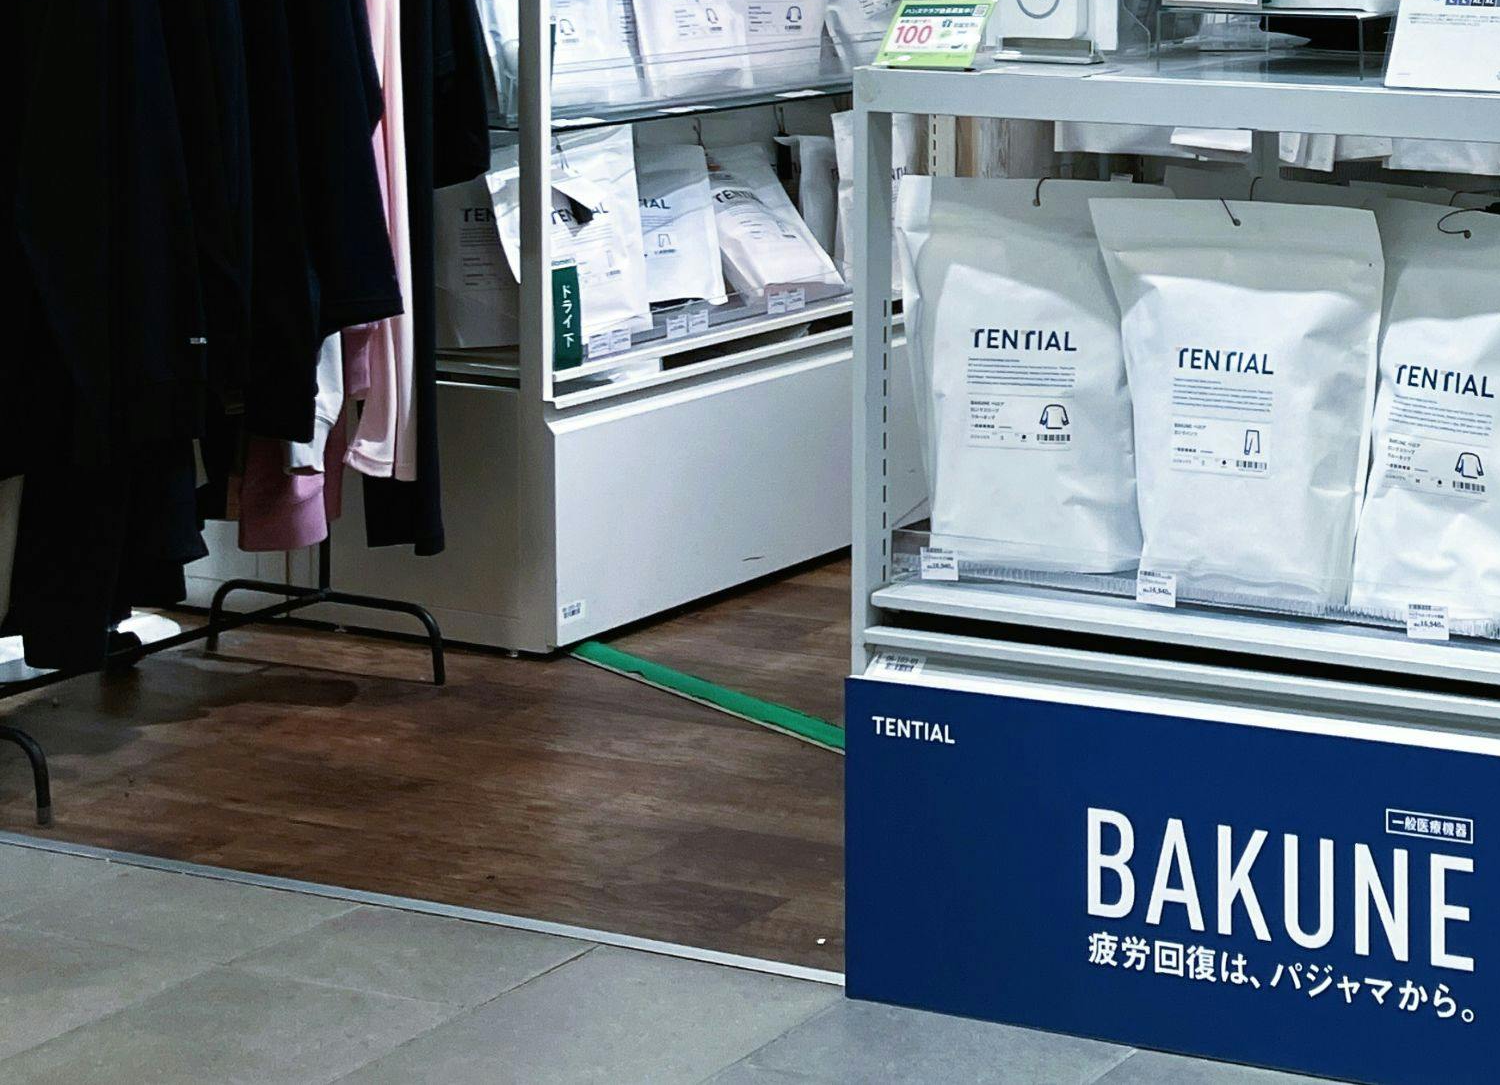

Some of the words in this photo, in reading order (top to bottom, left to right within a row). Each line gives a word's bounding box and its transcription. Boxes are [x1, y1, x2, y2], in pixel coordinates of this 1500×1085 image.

[894, 25, 933, 44] 100
[970, 327, 1078, 353] TENTIAL
[1175, 345, 1275, 377] TENTIAL
[1394, 362, 1495, 400] TENTIAL
[872, 715, 956, 745] TENTIAL
[1391, 814, 1468, 840] 一般医療機器
[1087, 806, 1475, 973] BAKUNE
[1088, 931, 1476, 1023] 疲労回復は、パジャマから。
